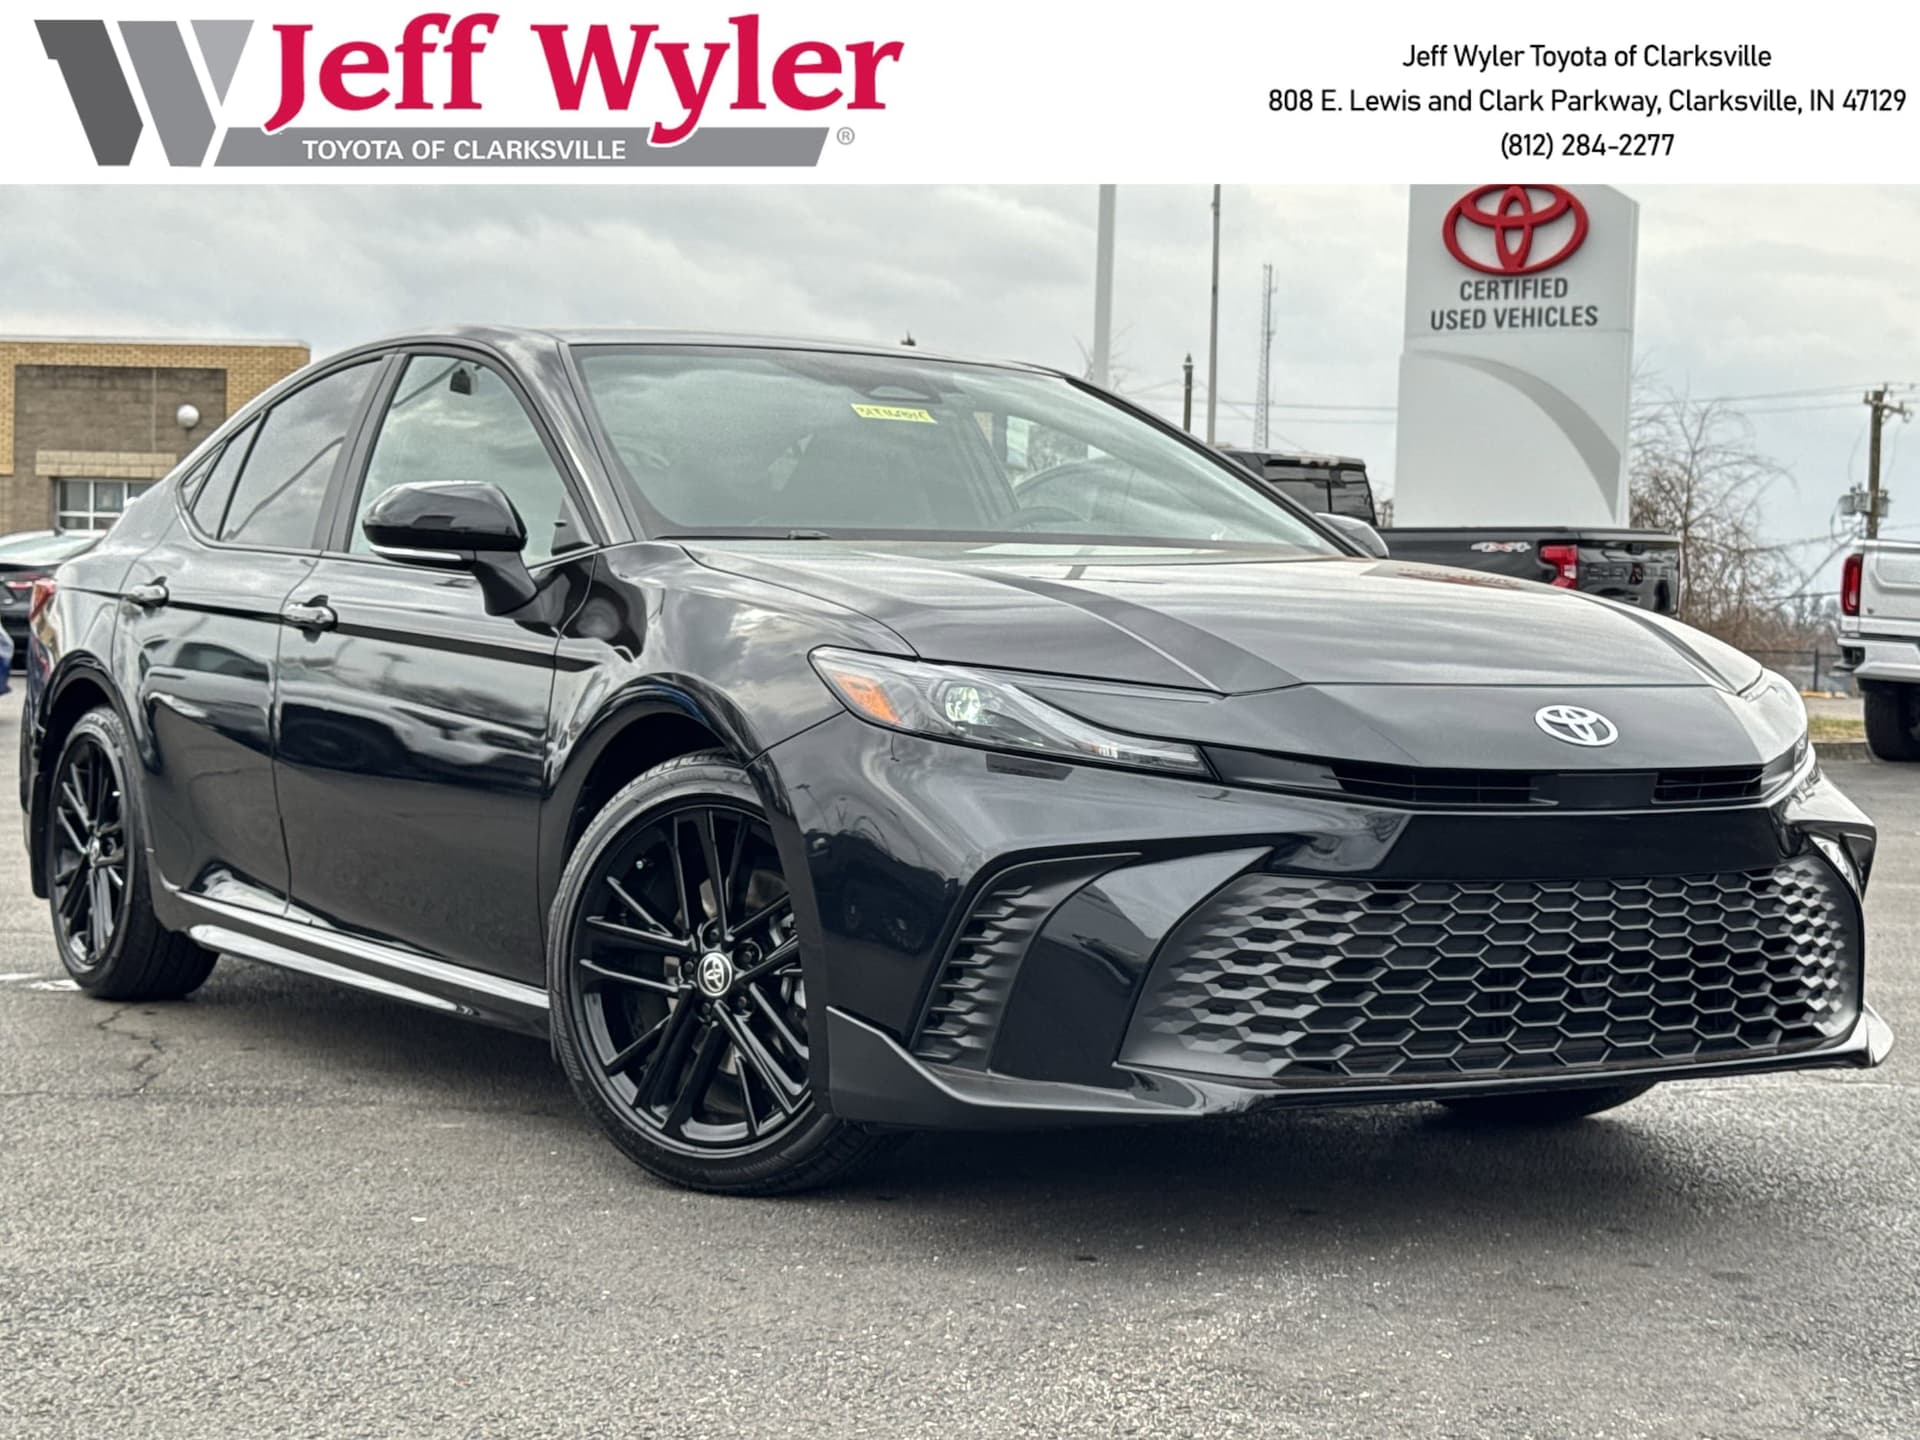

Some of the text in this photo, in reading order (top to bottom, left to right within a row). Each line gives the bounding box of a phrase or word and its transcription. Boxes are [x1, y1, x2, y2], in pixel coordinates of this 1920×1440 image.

[1459, 277, 1568, 301] CERTIFIED
[1431, 305, 1598, 331] USED VEHICLES
